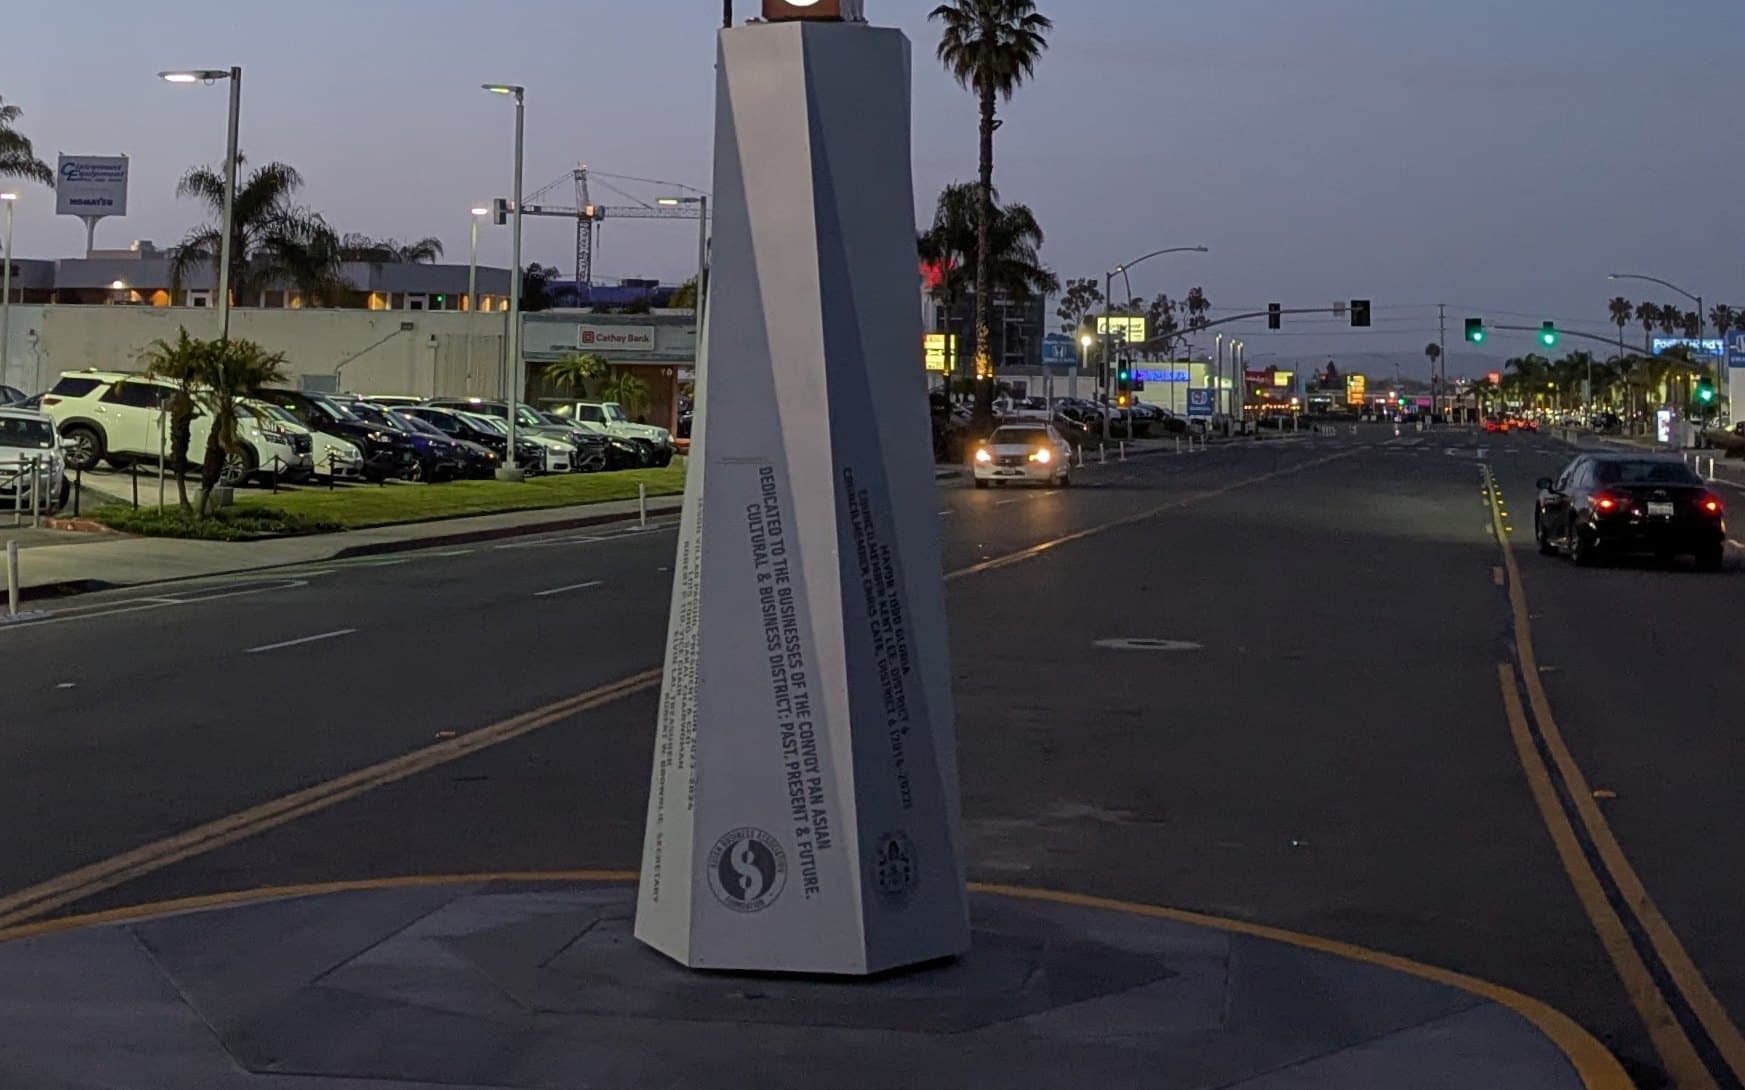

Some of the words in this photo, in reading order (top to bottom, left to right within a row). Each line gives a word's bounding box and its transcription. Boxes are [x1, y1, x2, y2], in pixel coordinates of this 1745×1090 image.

[70, 197, 113, 206] KOMATSU
[596, 333, 626, 343] Cathay
[628, 334, 649, 342] Bank
[759, 466, 782, 536] DEDICATED
[746, 504, 769, 569] CULTURAL
[770, 537, 786, 556] TO
[756, 572, 772, 583] &
[773, 558, 790, 584] THE
[843, 467, 870, 577] COUNCILMEMBER
[864, 579, 877, 616] CHRIS
[878, 659, 895, 714] DISTRICT
[759, 586, 781, 651] BUSINESS
[777, 587, 803, 669] BUSINESSES
[858, 488, 885, 597] COUNCILMEMBER
[879, 600, 893, 632] KENT
[890, 668, 909, 721] DISTRICT
[880, 544, 894, 587] MAYOR
[888, 591, 902, 625] TODD
[895, 629, 910, 675] GLORIA
[790, 672, 807, 688] OF
[793, 692, 811, 719] THE
[780, 722, 798, 760] PAST,
[799, 721, 820, 773] CONVOY
[785, 761, 809, 822] PRESENT
[806, 777, 825, 805] PAN
[796, 827, 810, 837] &
[811, 808, 832, 850] ASIAN
[653, 832, 663, 903] SECRETARY
[797, 841, 820, 900] FUTURE.
